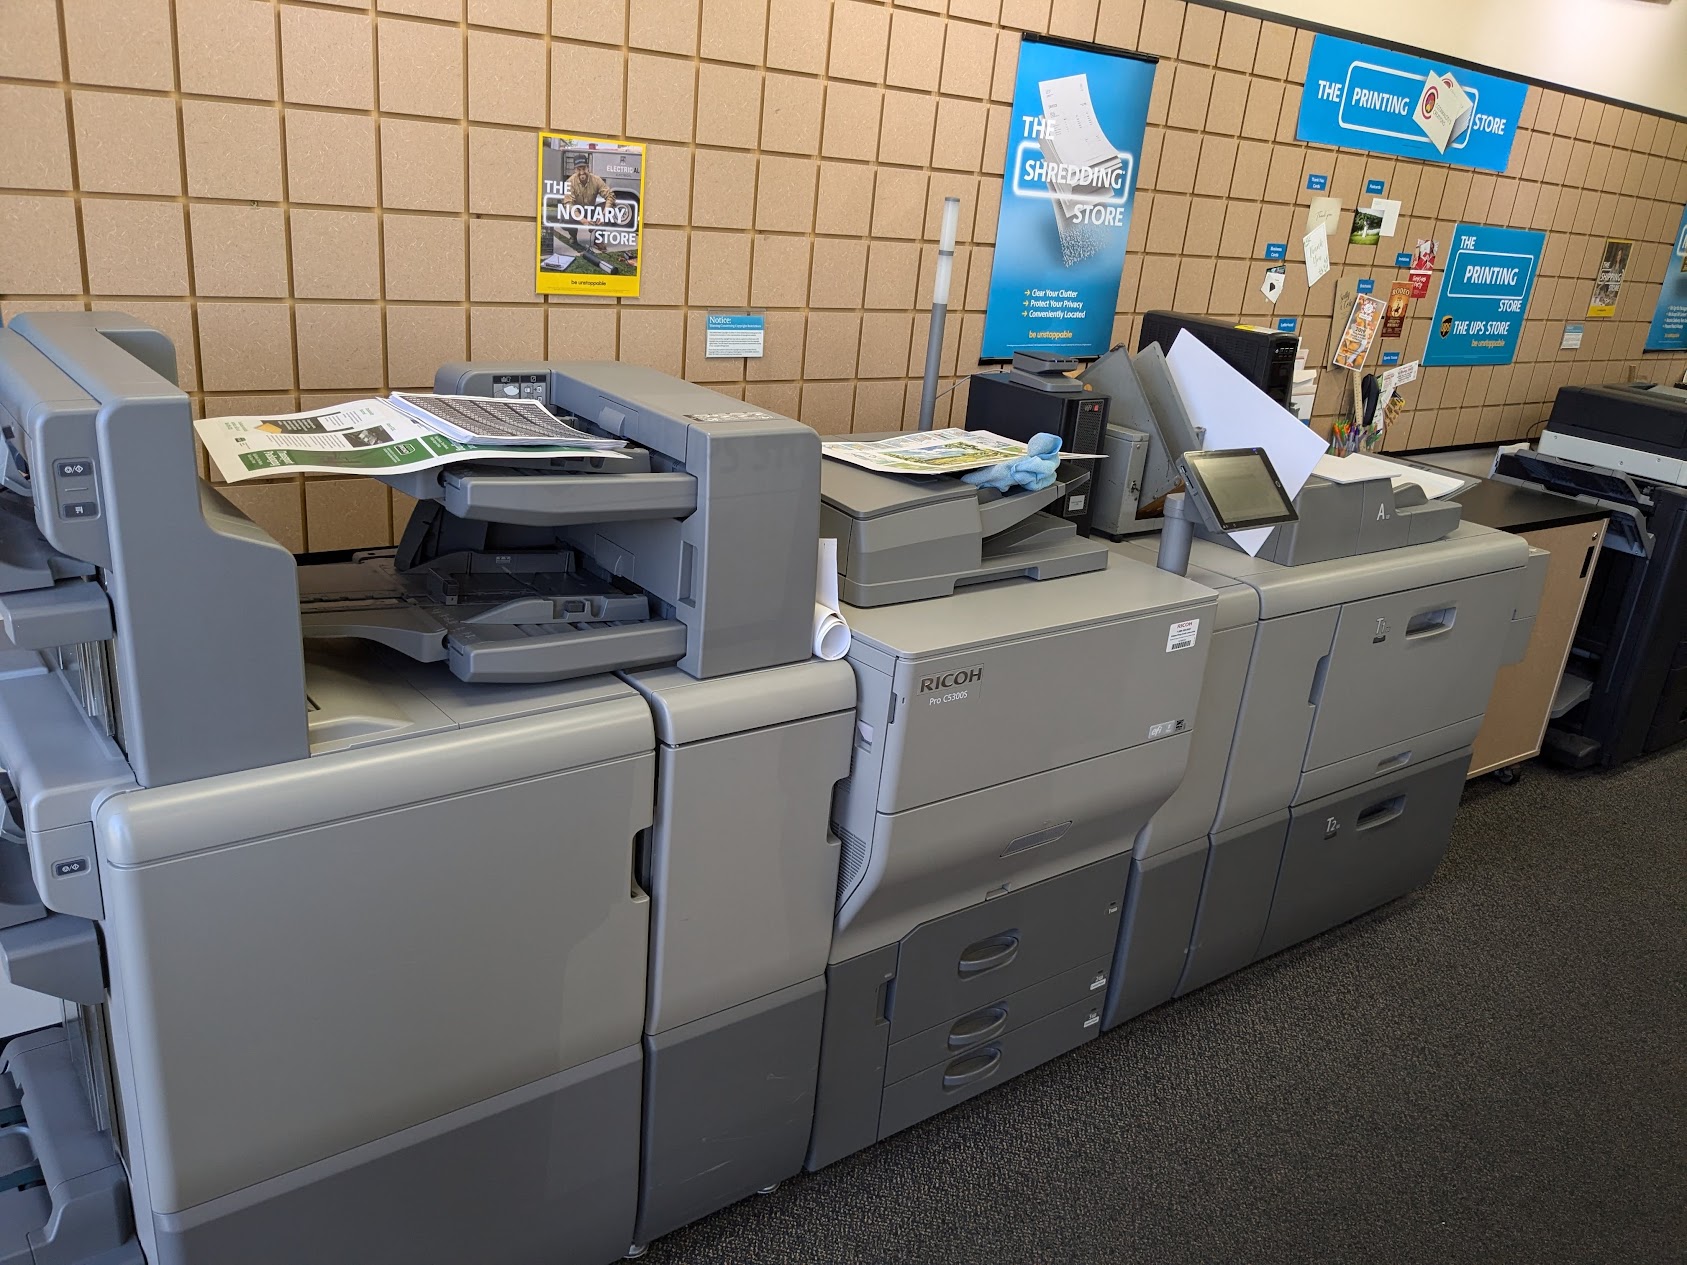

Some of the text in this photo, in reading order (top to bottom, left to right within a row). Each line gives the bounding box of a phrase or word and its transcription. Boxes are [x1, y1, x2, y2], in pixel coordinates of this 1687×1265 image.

[1318, 79, 1342, 103] THE
[1351, 87, 1410, 116] PRINTING
[1473, 113, 1507, 136] STORE
[1022, 115, 1057, 140] THE
[1023, 159, 1123, 190] SHREDDING
[544, 180, 572, 195] THE
[556, 203, 626, 224] NOTARY
[1072, 203, 1125, 227] STORE
[595, 230, 637, 246] STORE
[1460, 235, 1477, 250] THE
[1463, 265, 1520, 286] PRINTING
[1031, 289, 1046, 297] Clear
[1059, 290, 1079, 298] Clutter
[1030, 300, 1050, 308] Protect
[1063, 301, 1084, 309] Privacy
[1498, 299, 1523, 312] STORE
[709, 316, 732, 324] Notice:
[1028, 310, 1087, 320] Conveniently Located
[1453, 320, 1511, 335] THE UPS STORE
[1028, 331, 1073, 340] be unstoppable
[920, 668, 983, 692] RICOH
[929, 690, 968, 706] Pro C5300S
